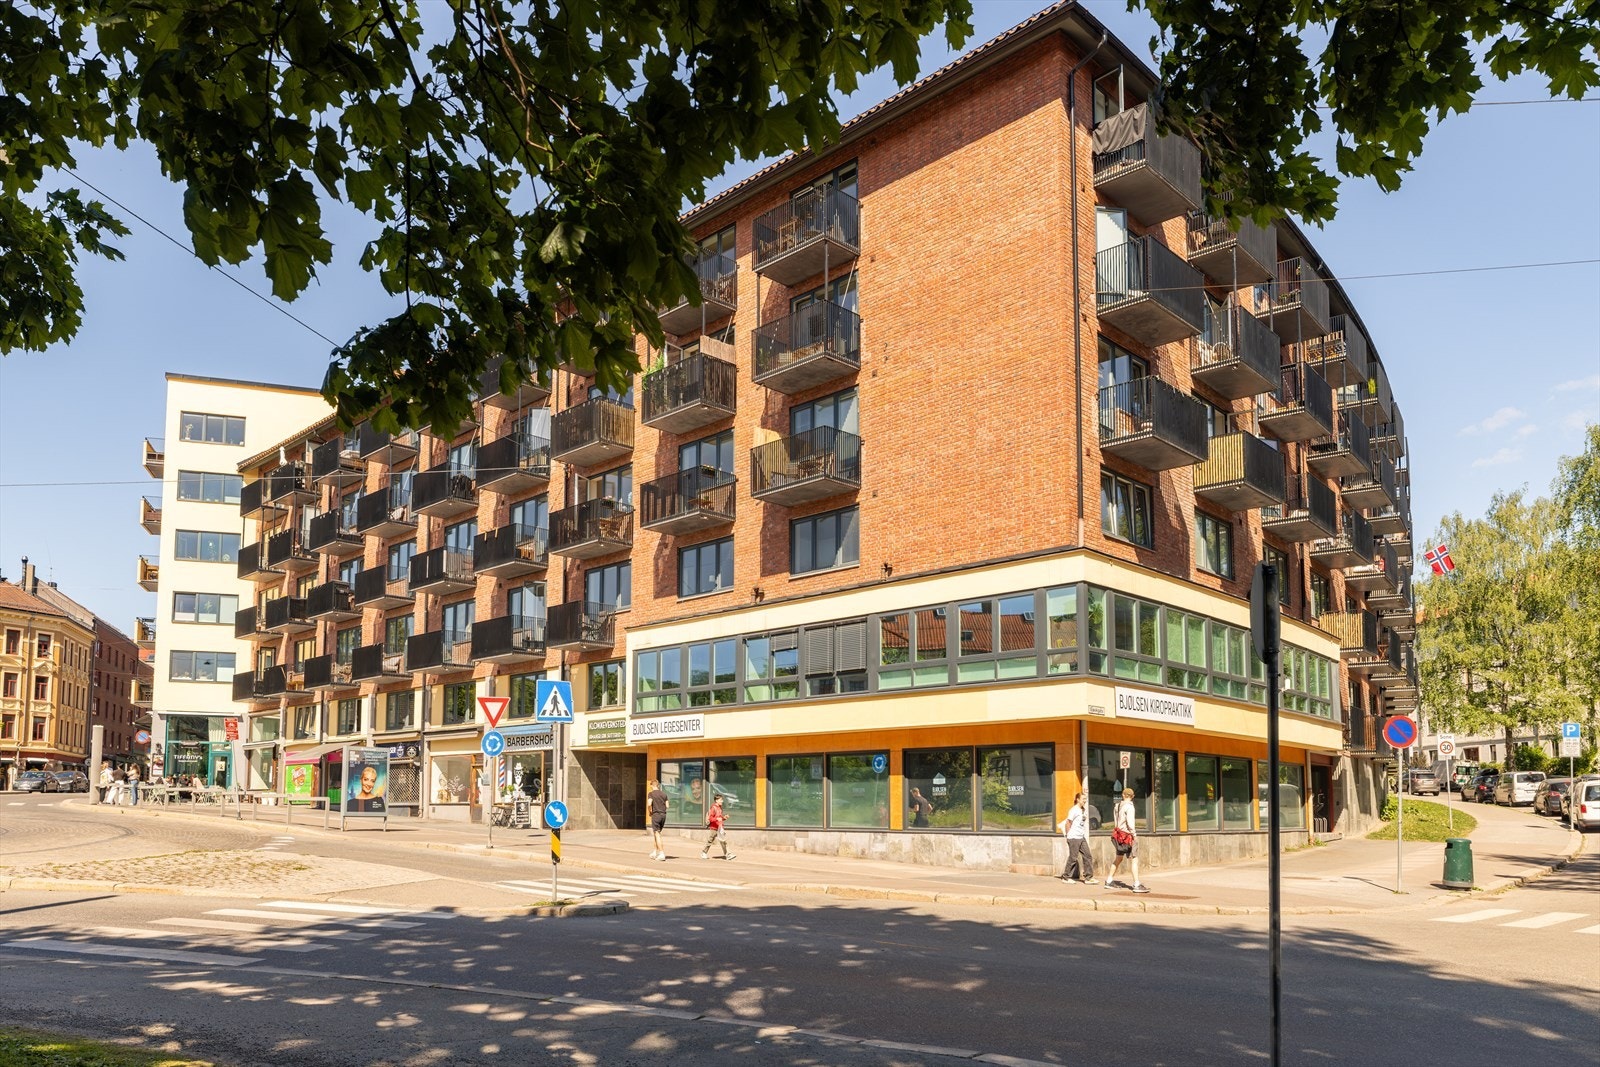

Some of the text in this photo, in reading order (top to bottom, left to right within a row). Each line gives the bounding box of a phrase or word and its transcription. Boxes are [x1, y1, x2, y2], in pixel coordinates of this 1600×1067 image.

[1150, 698, 1193, 718] KIROPRAKTIKK
[660, 719, 701, 734] LEGESENTER
[1567, 725, 1577, 736] P
